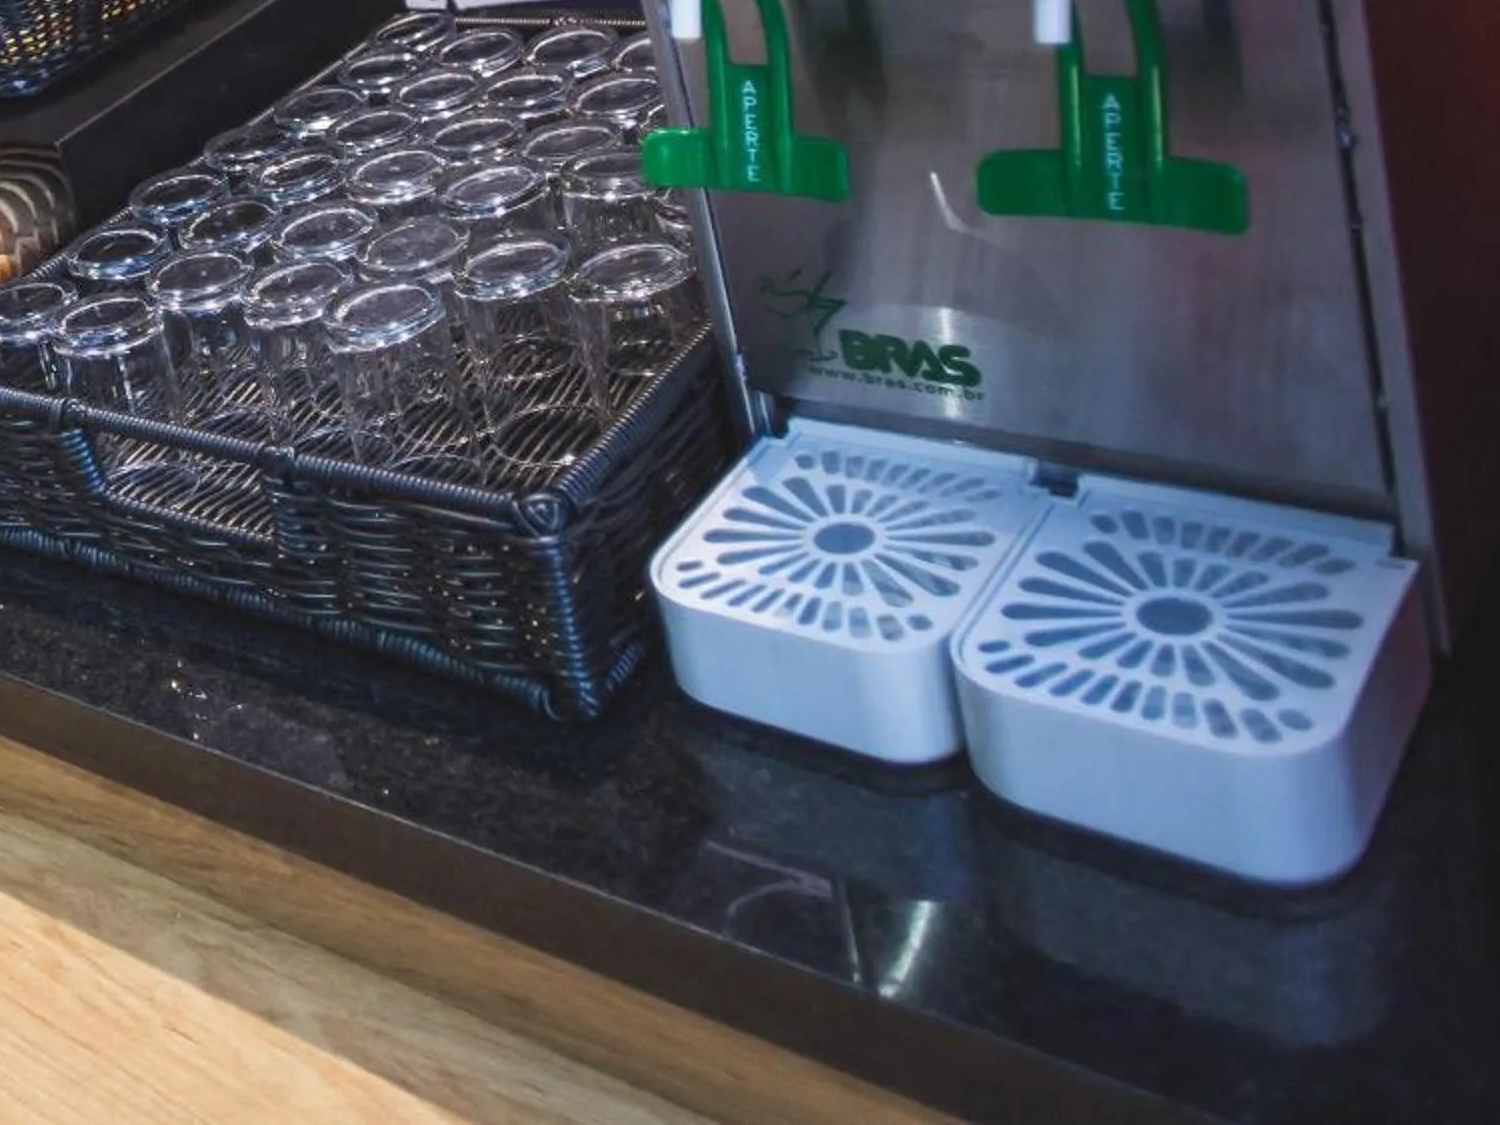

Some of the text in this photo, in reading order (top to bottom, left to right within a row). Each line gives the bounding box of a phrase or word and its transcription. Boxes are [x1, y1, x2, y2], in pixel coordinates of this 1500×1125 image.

[742, 79, 761, 183] APERTE
[1101, 93, 1124, 210] APERTE
[838, 329, 982, 388] BRAS
